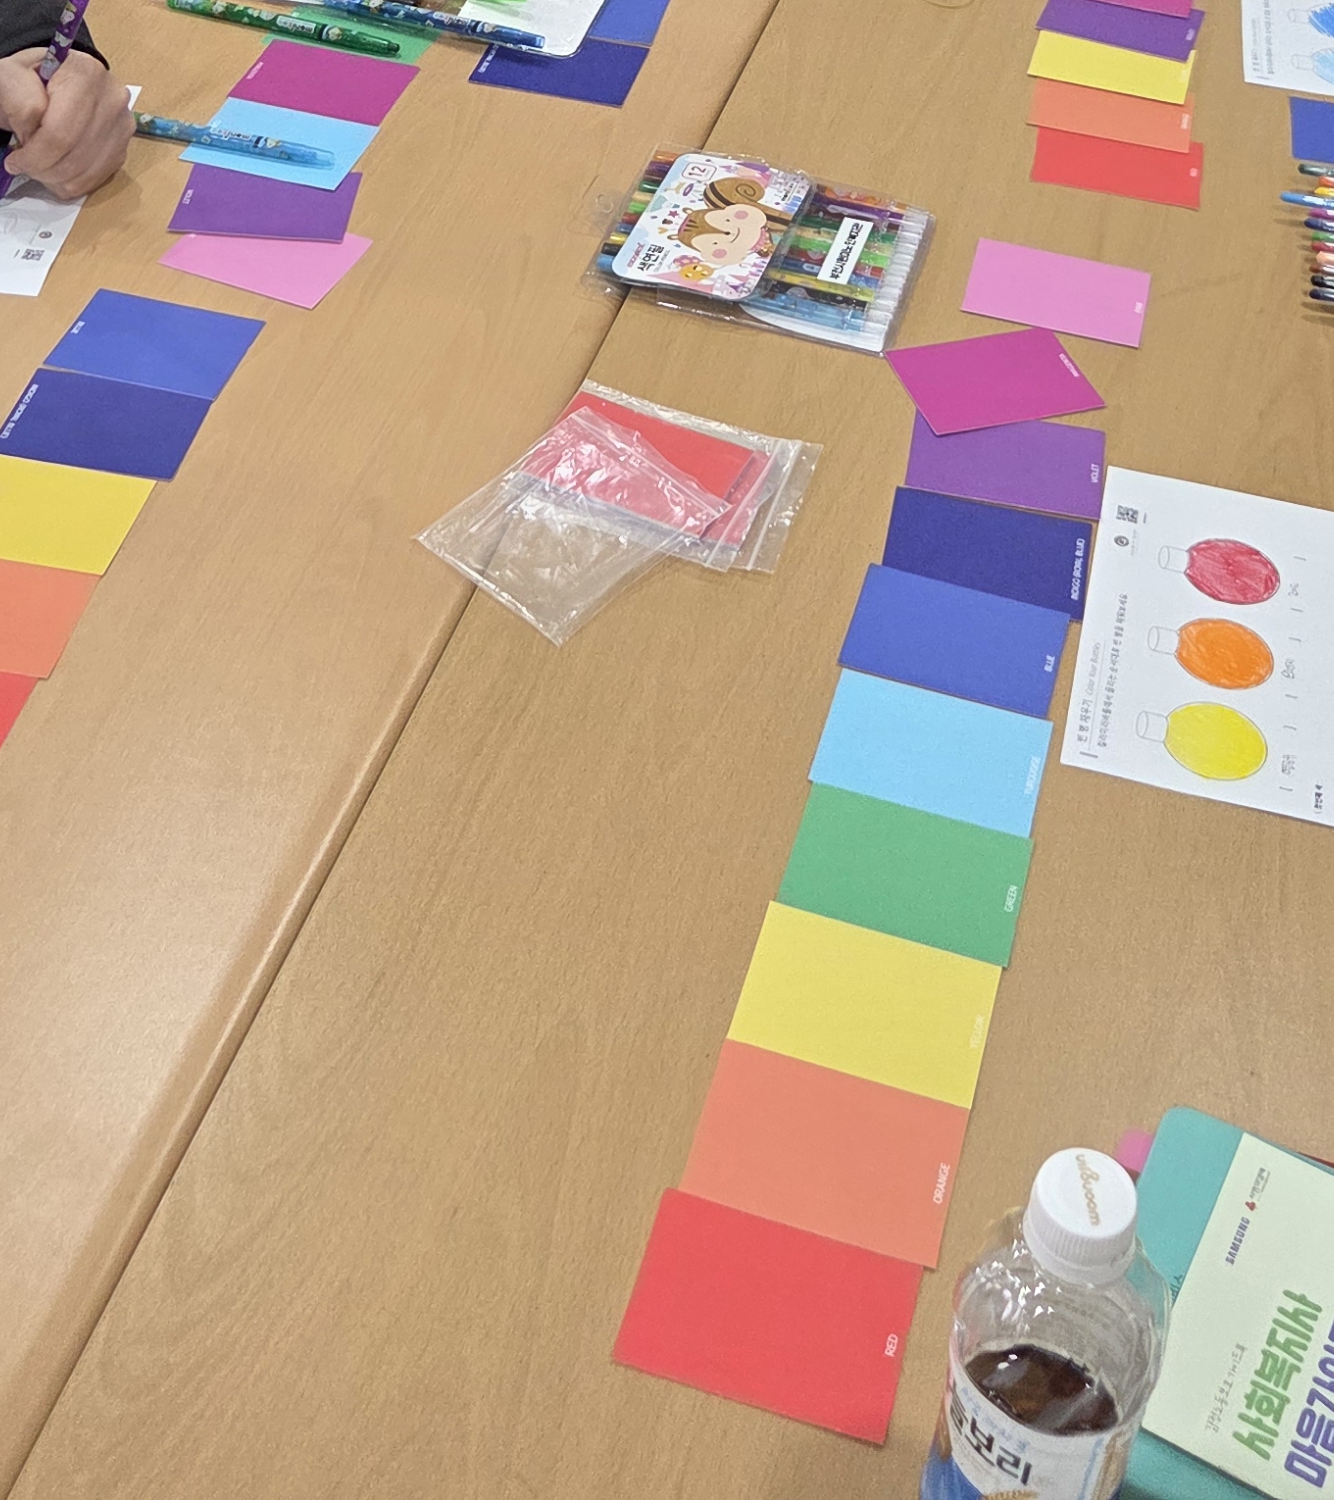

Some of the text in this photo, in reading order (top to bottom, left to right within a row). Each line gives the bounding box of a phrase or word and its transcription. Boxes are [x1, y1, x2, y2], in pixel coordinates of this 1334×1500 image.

[688, 166, 707, 183] 12
[639, 241, 665, 273] 색연필
[1090, 463, 1100, 483] VIOLET
[1070, 578, 1081, 600] INDIGO
[1044, 654, 1055, 673] BLUE
[1085, 679, 1095, 696] Color
[1004, 885, 1018, 912] GREEN
[969, 1014, 985, 1048] YELLOW
[933, 1163, 950, 1204] ORANGE
[1075, 1153, 1101, 1227] woongjin
[1225, 1217, 1250, 1265] SAMSUNG
[884, 1333, 898, 1357] RED
[1233, 1289, 1324, 1460] 사회복지사
